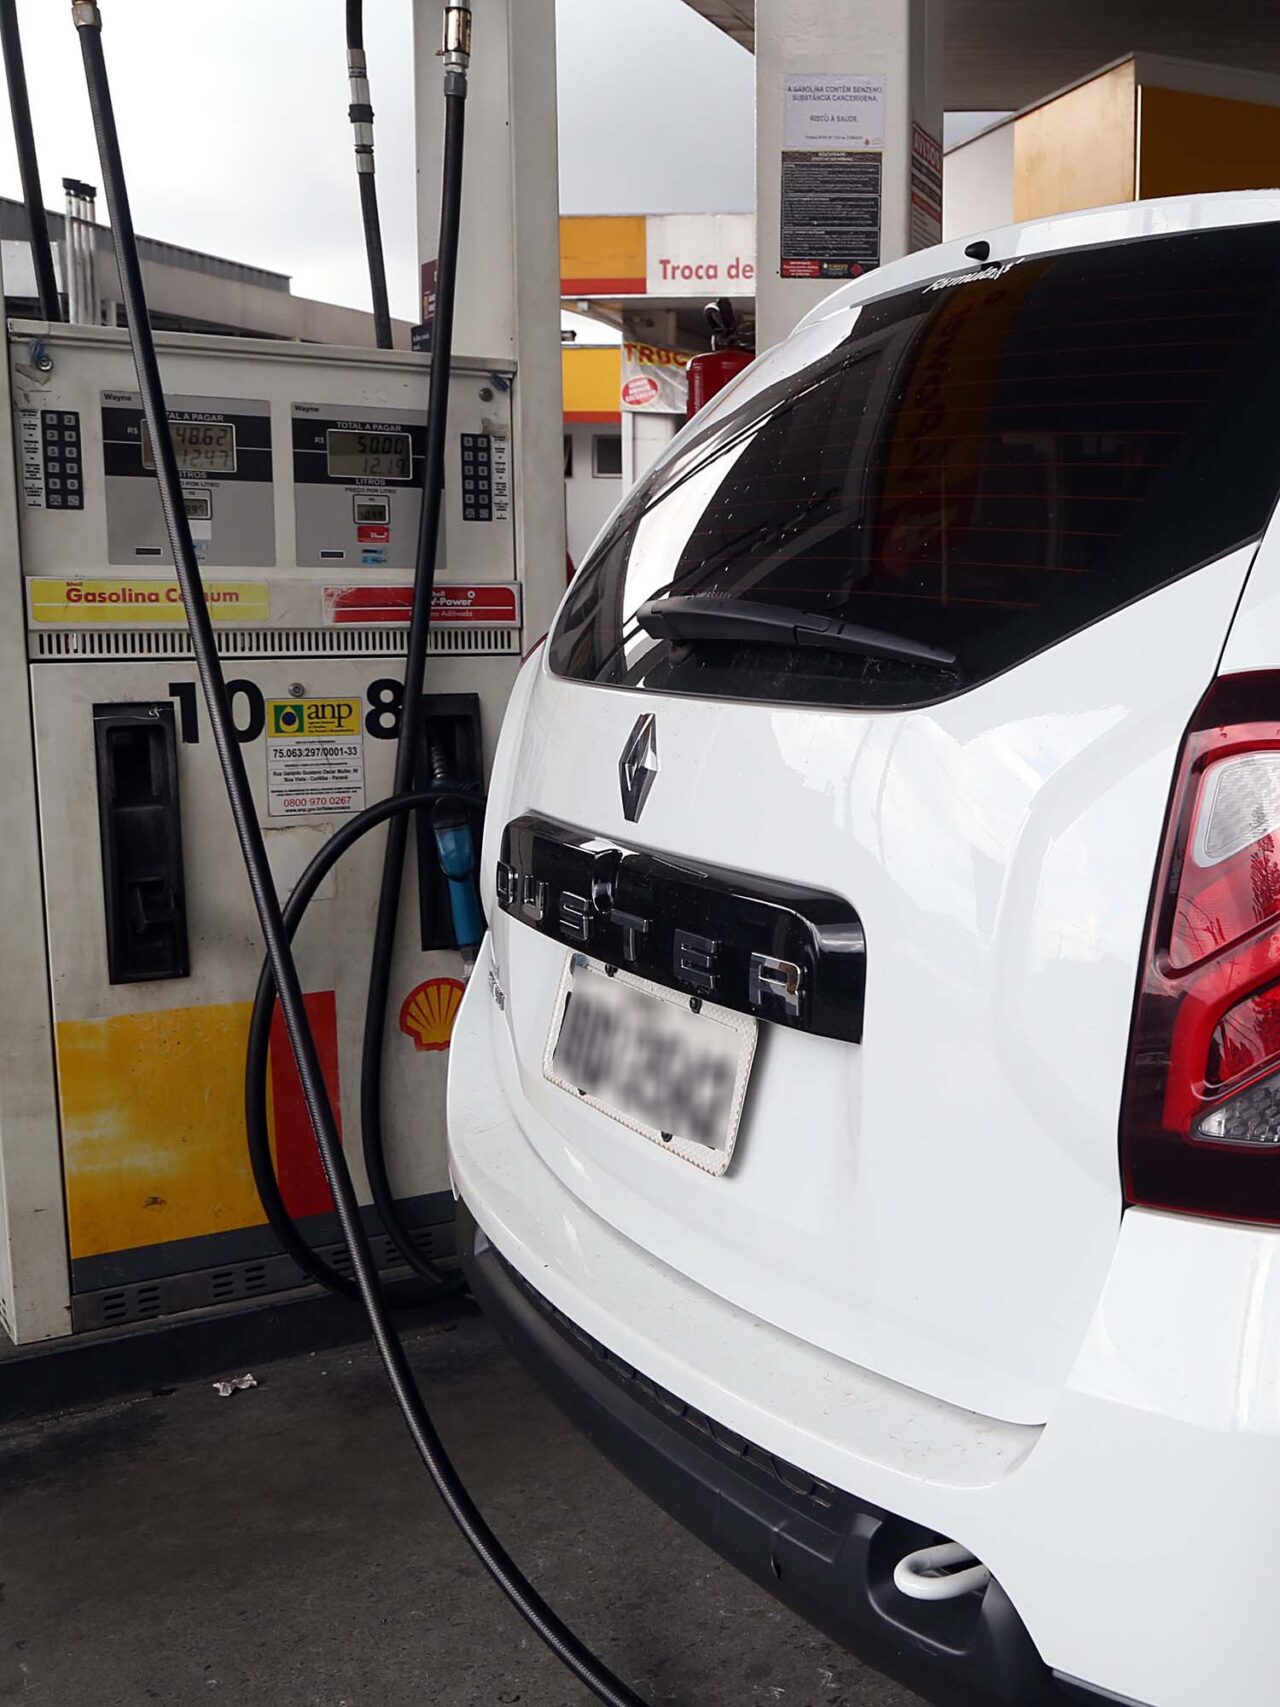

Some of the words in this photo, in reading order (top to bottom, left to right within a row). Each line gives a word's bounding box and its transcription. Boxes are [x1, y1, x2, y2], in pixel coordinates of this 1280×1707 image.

[658, 258, 718, 280] Troca
[727, 256, 754, 280] de
[623, 343, 687, 367] TROC
[104, 393, 132, 401] Wayne
[294, 405, 320, 413] Wayne
[191, 413, 225, 422] PAGAR
[127, 426, 139, 434] R$
[337, 421, 362, 430] TOTAL
[373, 424, 402, 432] PAGAR
[176, 427, 228, 446] 48.62
[180, 471, 208, 479] ITROS
[355, 478, 386, 486] LITROS
[65, 588, 160, 603] Gasolina
[365, 678, 405, 740] 8
[307, 703, 353, 728] anp
[273, 746, 358, 759] 75.063.297/0001-33
[284, 798, 307, 807] 0800
[309, 797, 327, 805] 970
[329, 796, 352, 805] 0267
[497, 861, 803, 1016] DUSTER
